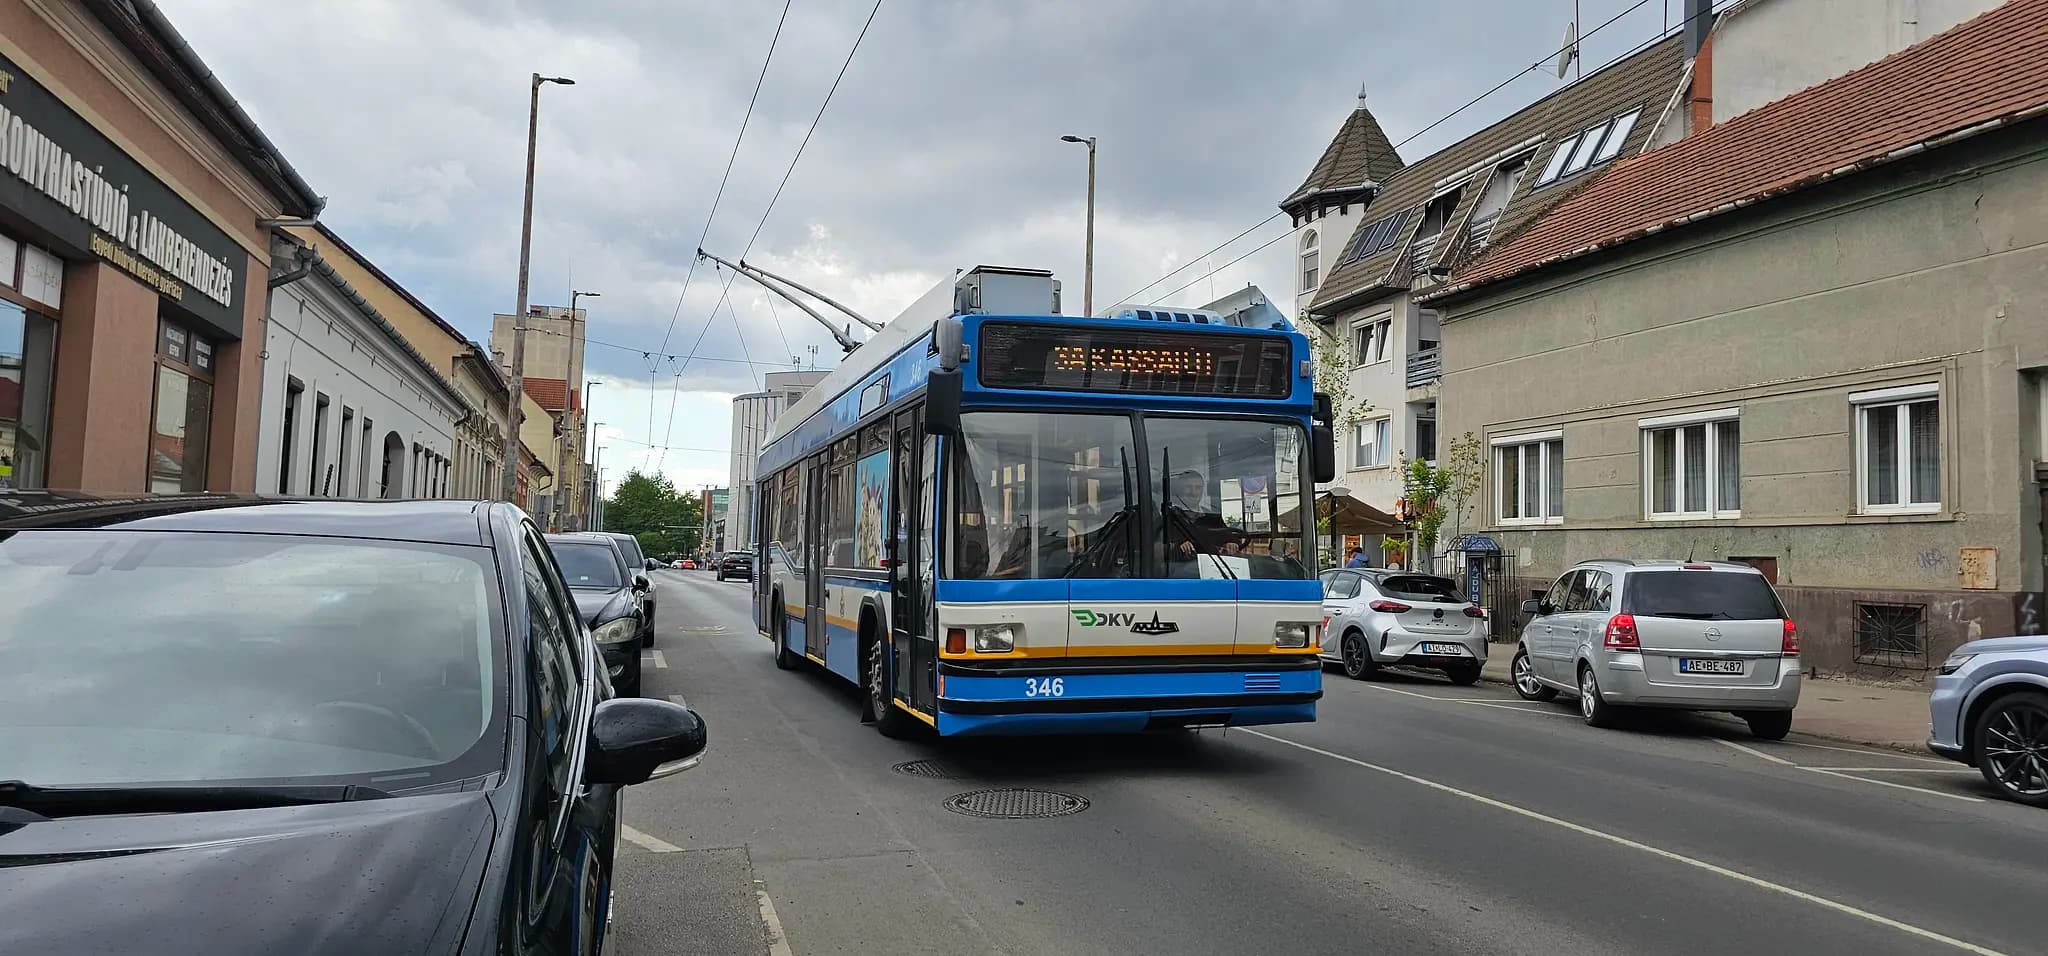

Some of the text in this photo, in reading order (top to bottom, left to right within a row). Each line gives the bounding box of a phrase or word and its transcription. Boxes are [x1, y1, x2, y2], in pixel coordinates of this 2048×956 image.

[90, 232, 114, 260] Egyedi
[129, 215, 139, 250] &
[138, 209, 233, 308] LAKBERENDEZÉS
[1095, 612, 1136, 627] DKV
[1688, 660, 1741, 672] AE BE-487
[1025, 677, 1065, 697] 346
